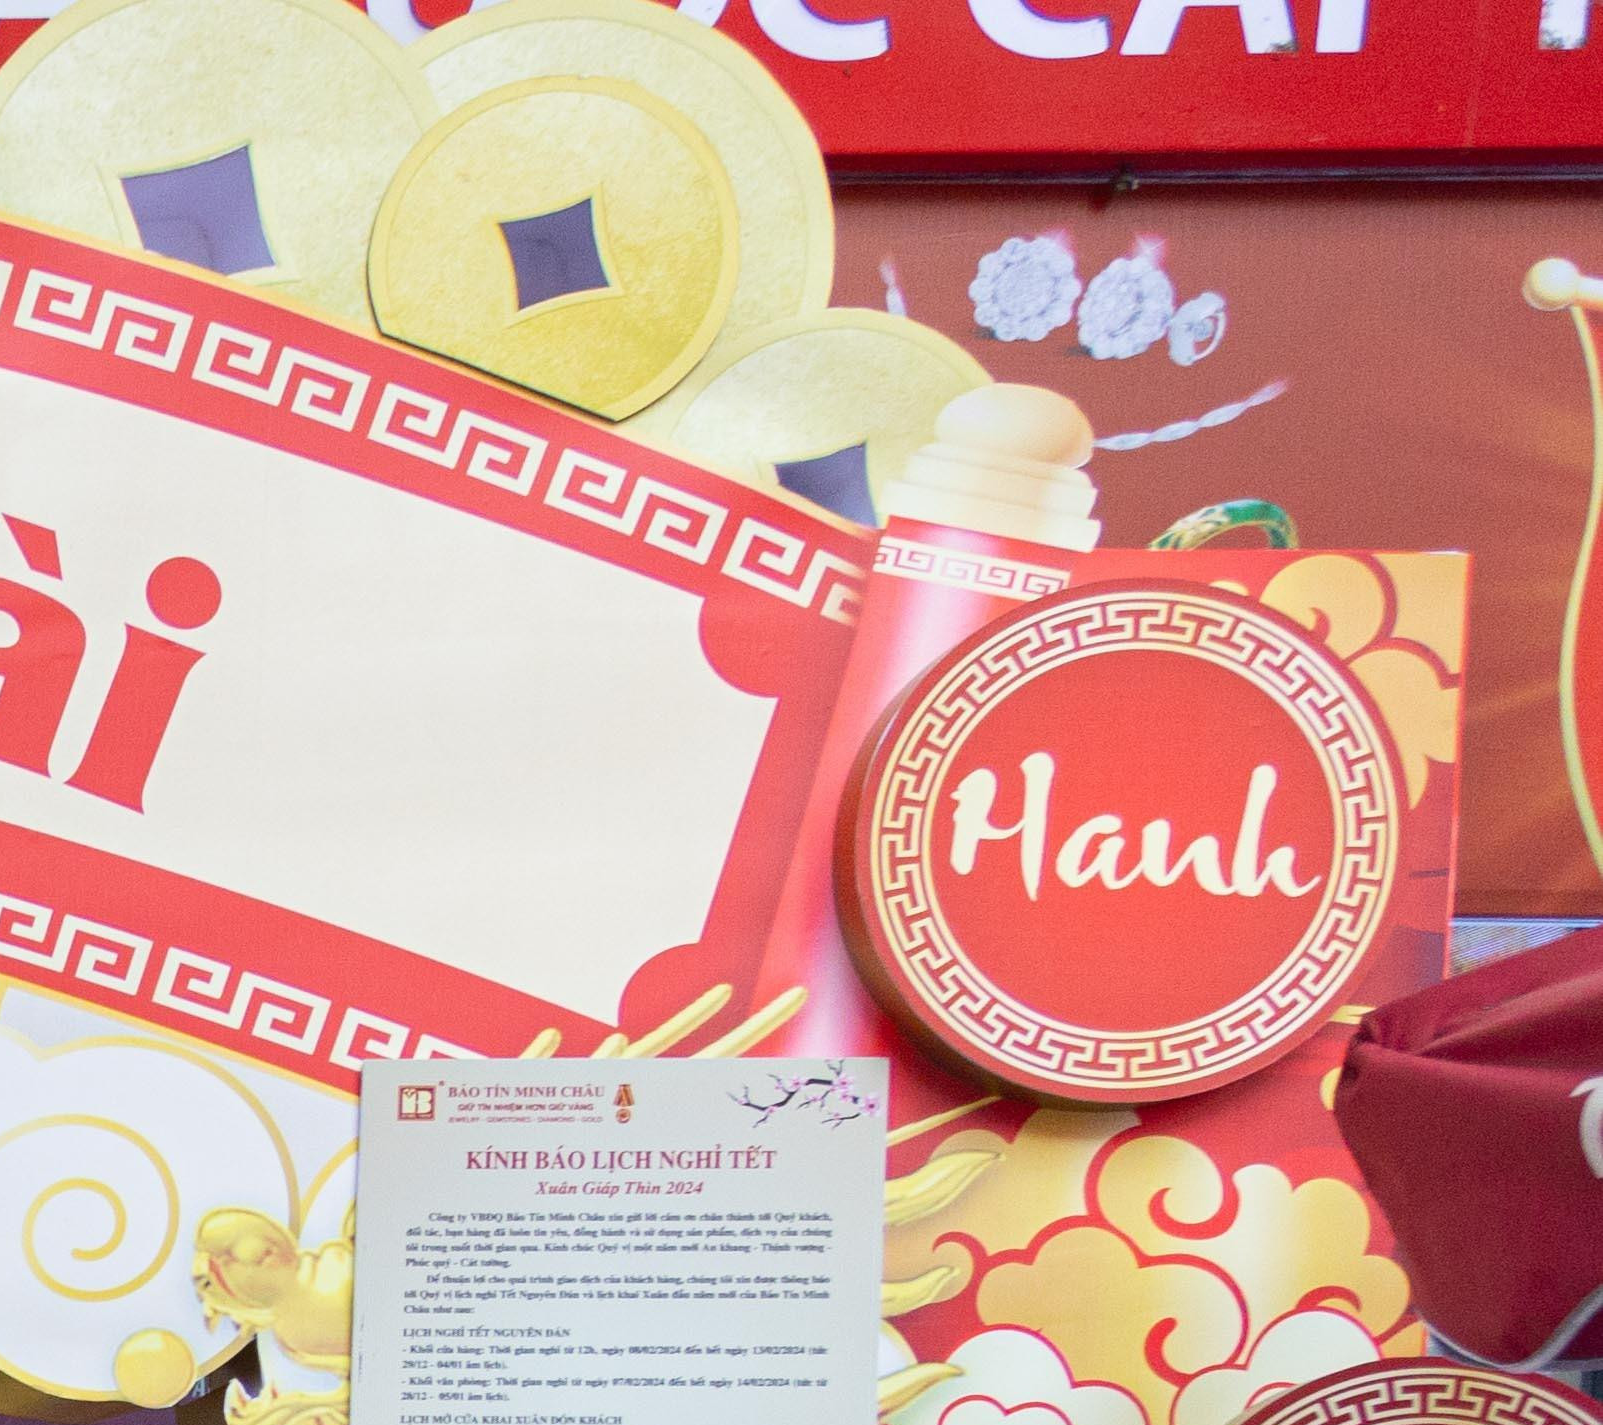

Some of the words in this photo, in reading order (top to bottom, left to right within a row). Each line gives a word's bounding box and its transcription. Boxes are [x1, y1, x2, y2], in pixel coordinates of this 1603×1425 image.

[517, 1086, 557, 1097] MINH
[465, 1145, 528, 1170] KÍNH
[534, 1145, 586, 1170] BÁO
[592, 1150, 652, 1174] LỊCH
[659, 1143, 722, 1170] NGHỈ
[727, 1144, 778, 1170] TẾT
